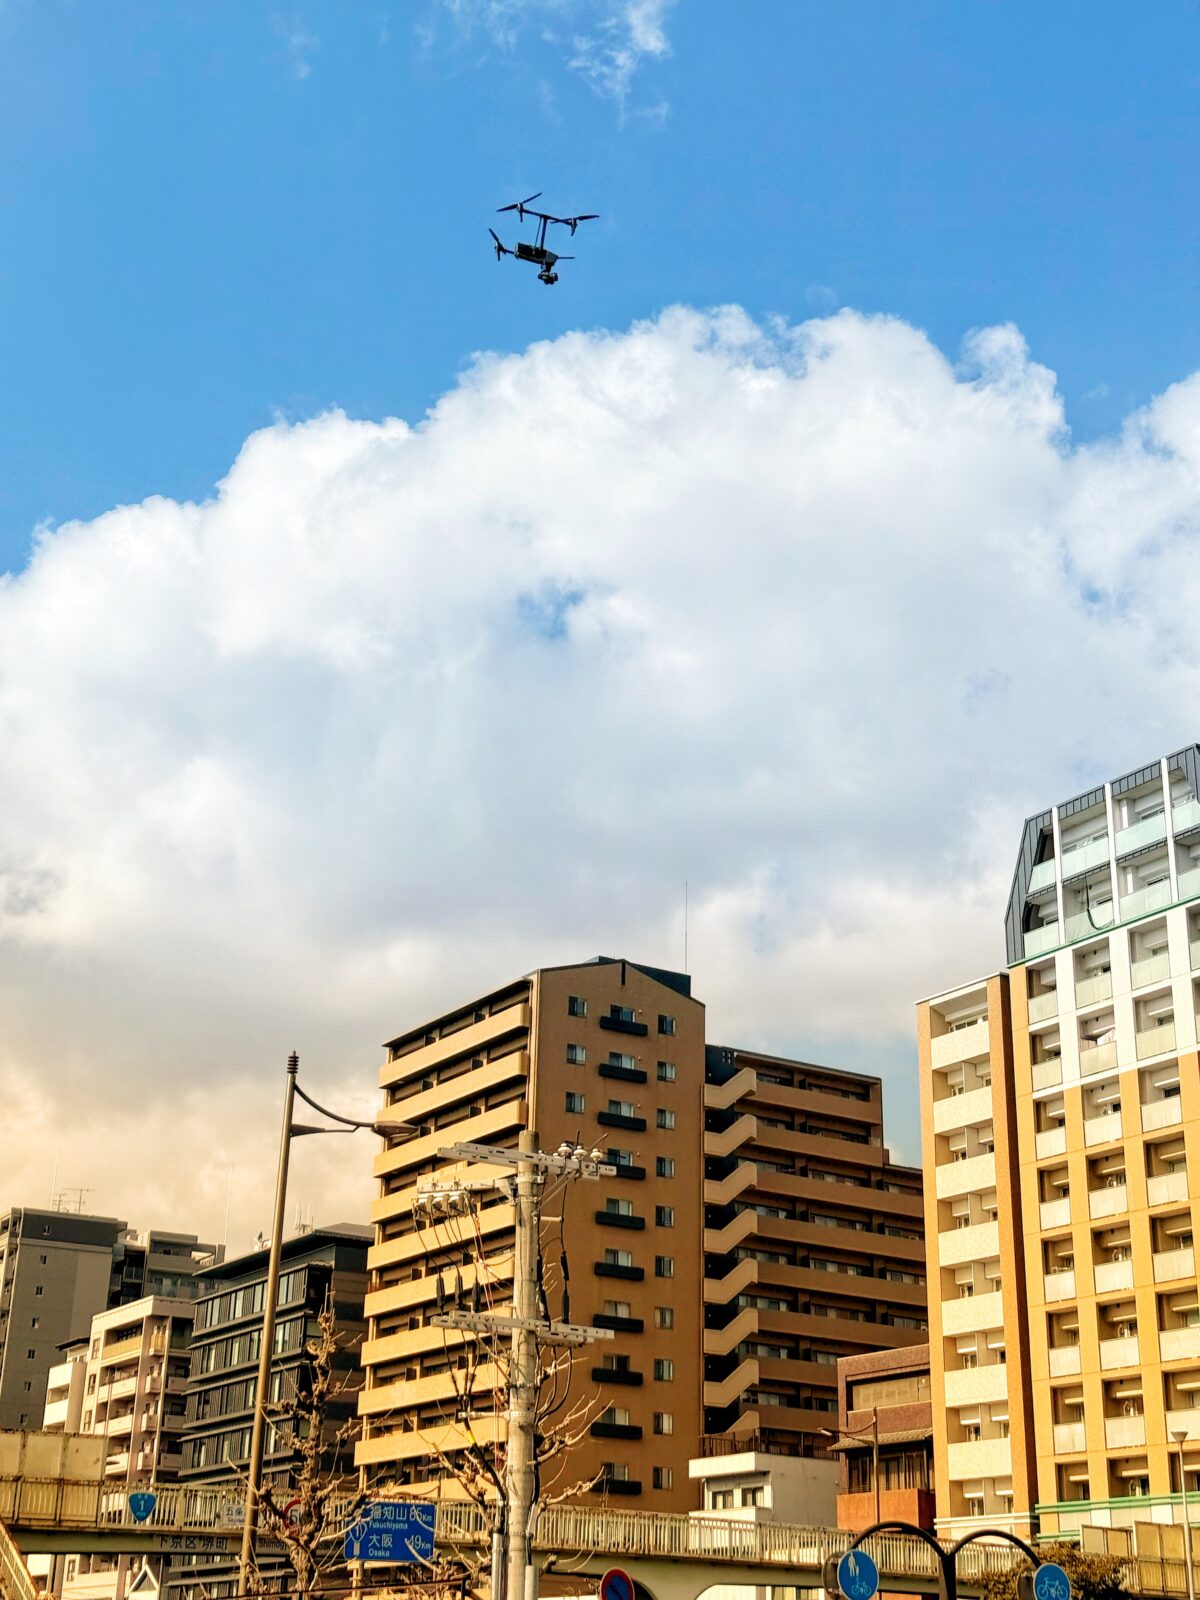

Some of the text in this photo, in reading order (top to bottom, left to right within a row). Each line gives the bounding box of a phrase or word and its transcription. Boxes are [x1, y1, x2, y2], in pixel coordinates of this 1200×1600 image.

[139, 1499, 144, 1511] 1
[369, 1505, 407, 1521] 福知山
[369, 1521, 408, 1531] Fukuchiyama
[368, 1533, 393, 1548] 大阪
[368, 1549, 391, 1557] Osaka
